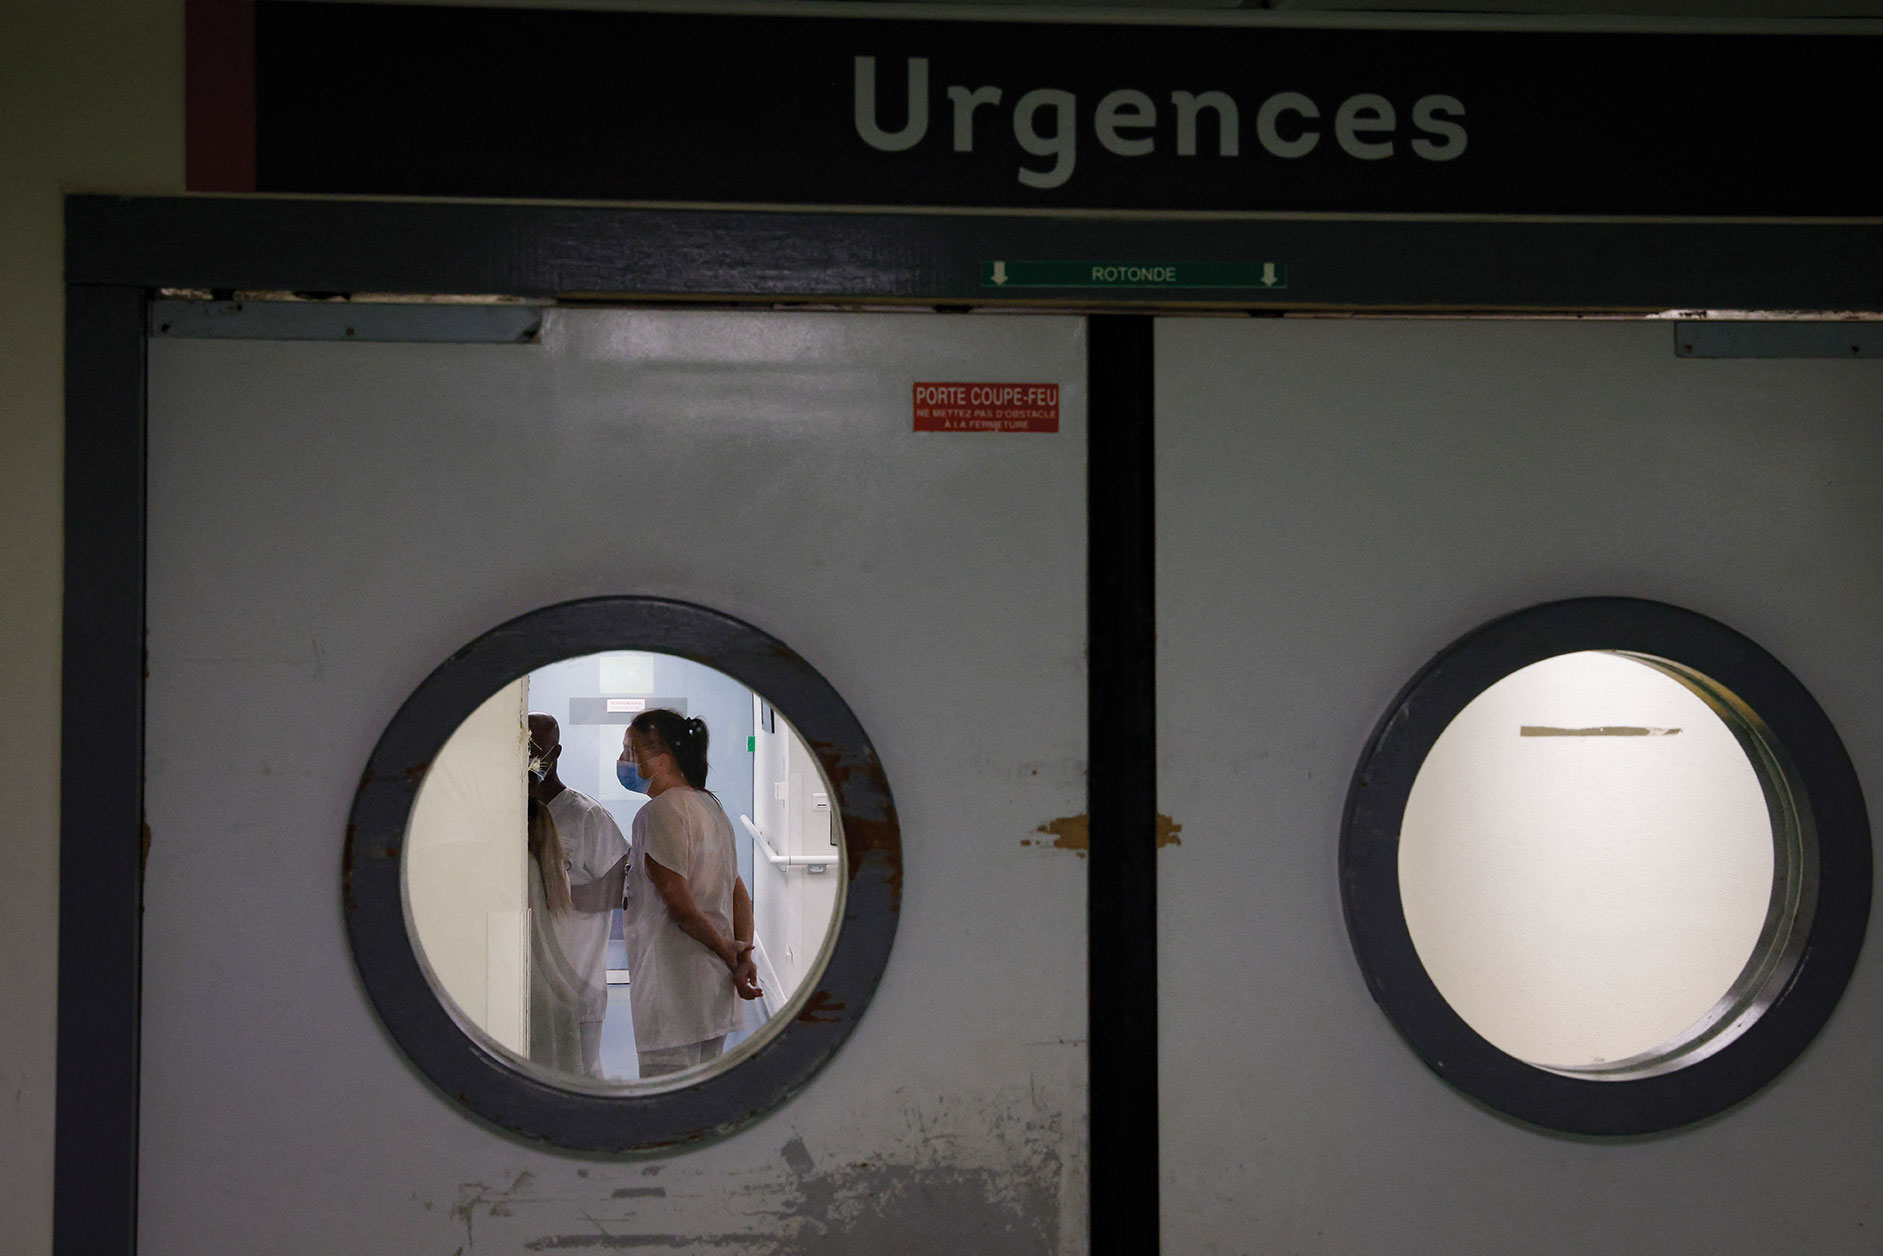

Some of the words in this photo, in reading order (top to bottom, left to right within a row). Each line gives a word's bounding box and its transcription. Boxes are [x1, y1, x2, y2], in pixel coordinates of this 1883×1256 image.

[854, 56, 1468, 189] Urgences
[1091, 266, 1176, 282] ROTONDE
[916, 387, 966, 405] PORTE
[970, 387, 1057, 406] COUPE-FEU
[916, 409, 930, 418] NE
[932, 409, 972, 418] METTEZ
[974, 409, 993, 418] PAS
[954, 420, 967, 429] LA
[969, 420, 1030, 429] FERMETURE
